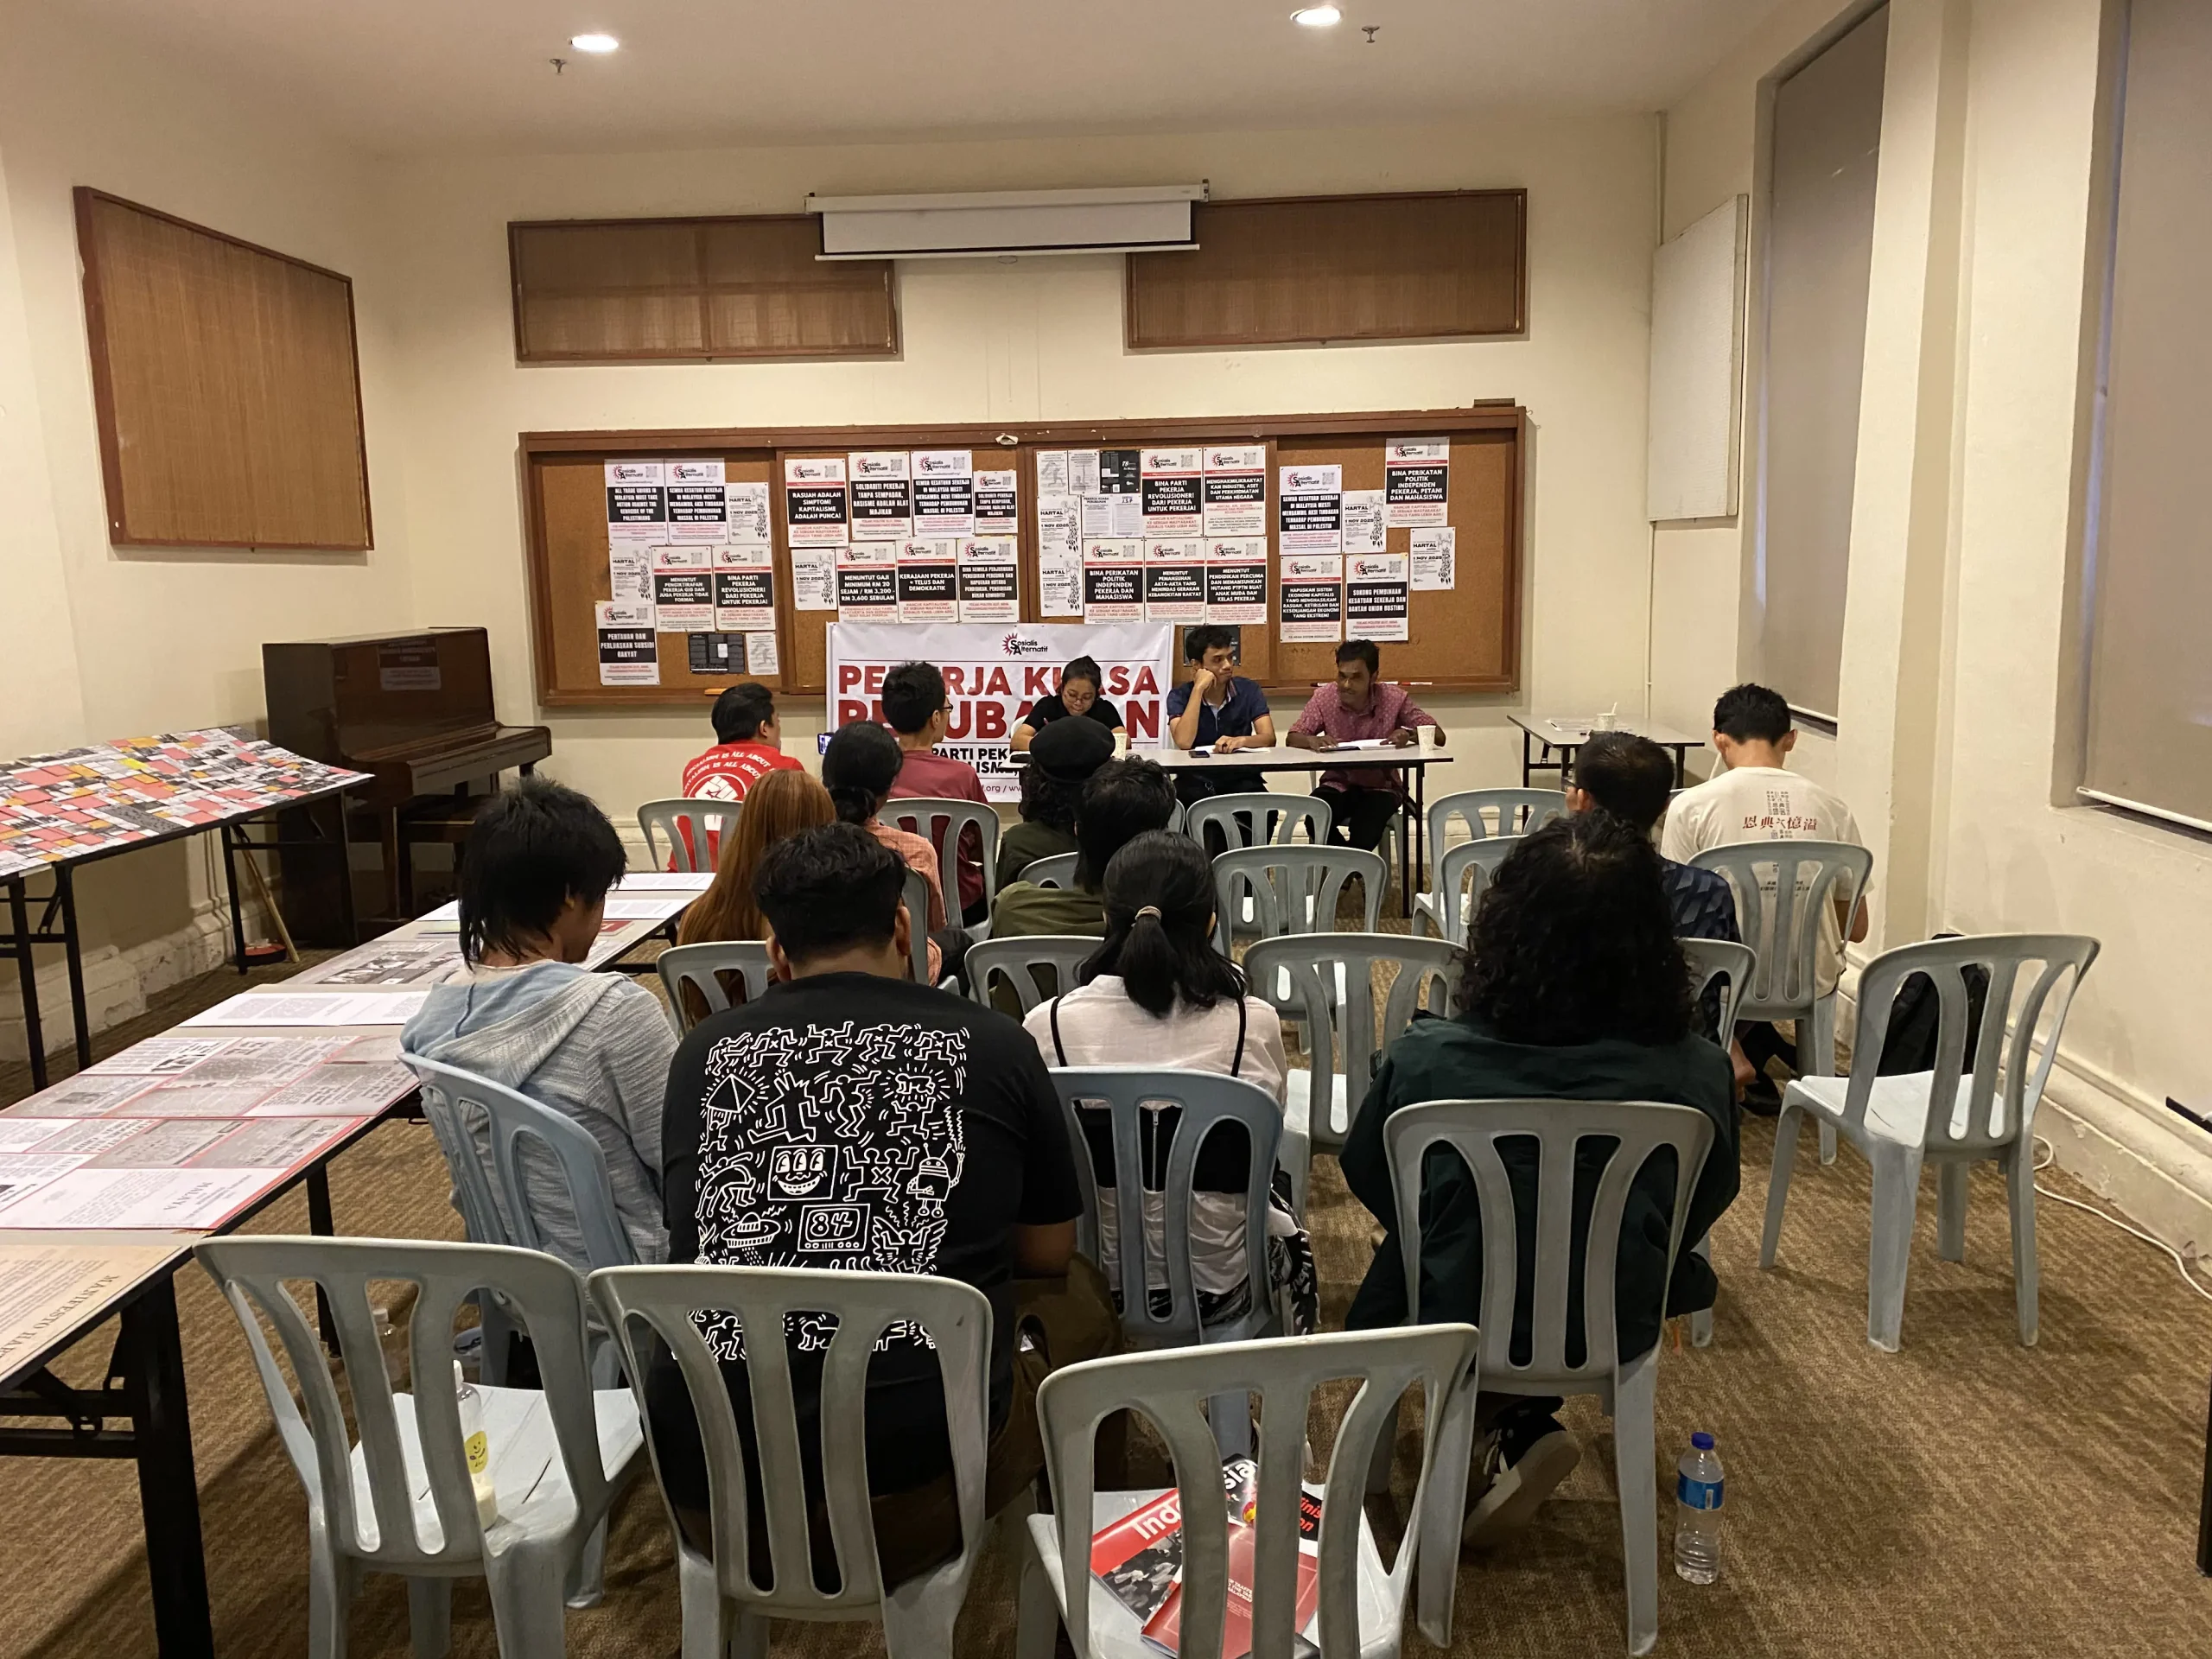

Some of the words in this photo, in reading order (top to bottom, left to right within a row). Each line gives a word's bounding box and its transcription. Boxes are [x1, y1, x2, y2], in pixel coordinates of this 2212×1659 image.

[1011, 639, 1038, 648] Sosialis
[1014, 646, 1048, 655] Alternatif
[839, 665, 1012, 696] PERJA
[1025, 666, 1160, 696] KSA
[747, 753, 771, 767] ABOUT
[810, 1212, 853, 1237] 84
[34, 1275, 121, 1329] MANIFESTO
